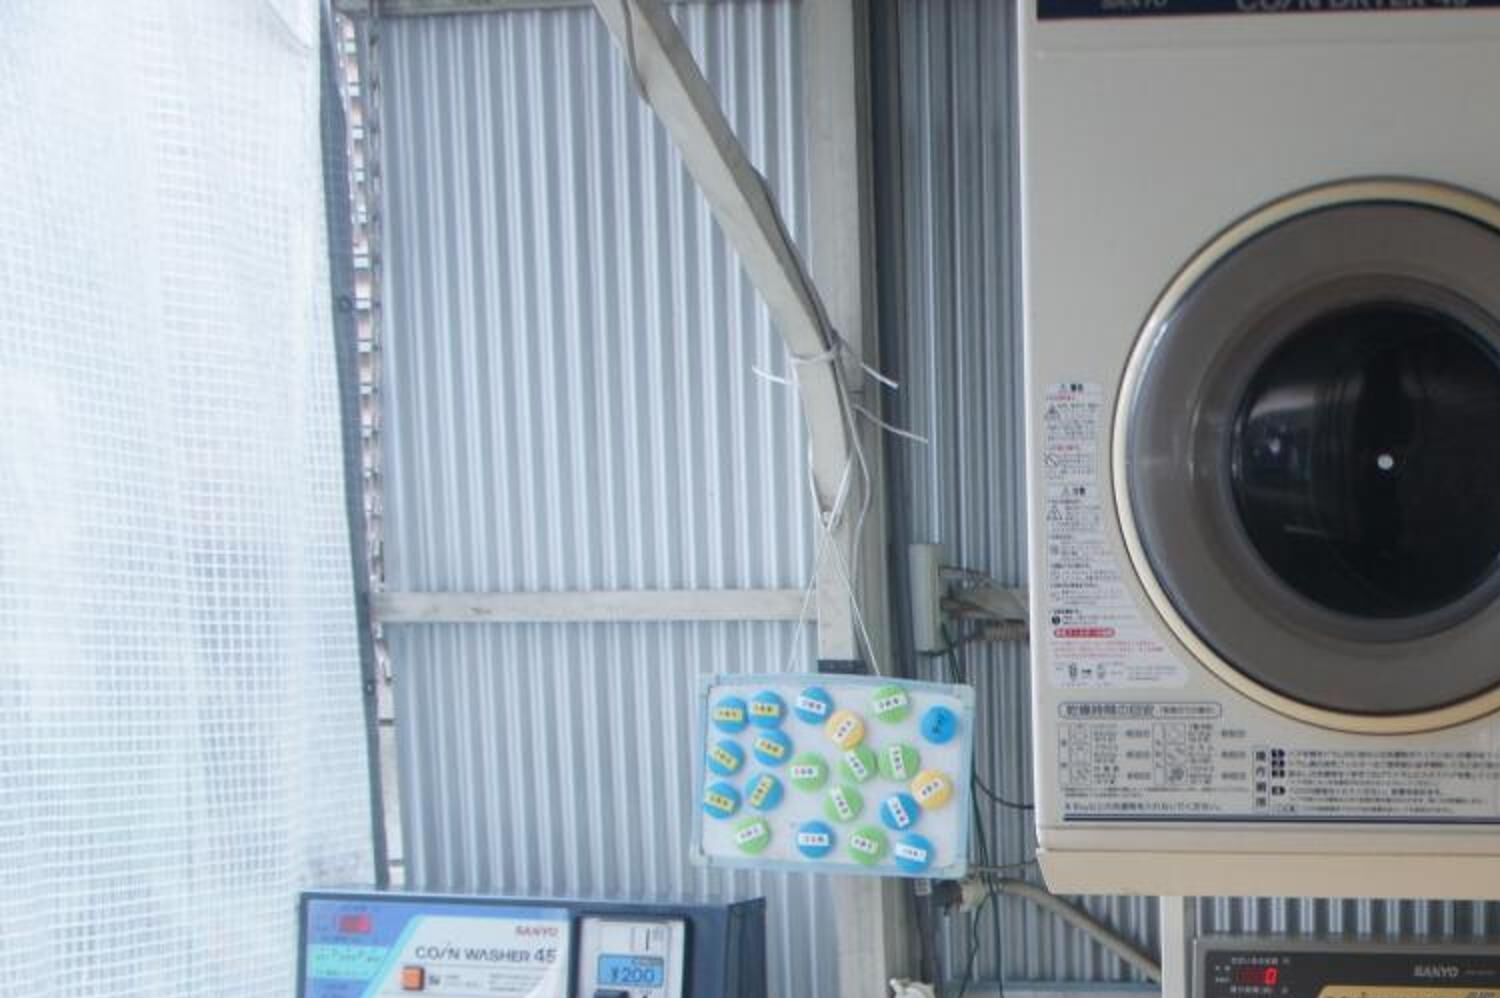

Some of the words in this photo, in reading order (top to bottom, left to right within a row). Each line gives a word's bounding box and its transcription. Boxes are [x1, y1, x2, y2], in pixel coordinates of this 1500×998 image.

[464, 946, 530, 964] WASHER
[533, 945, 558, 964] 45
[1263, 966, 1279, 985] 0
[1412, 964, 1460, 978] SANYO
